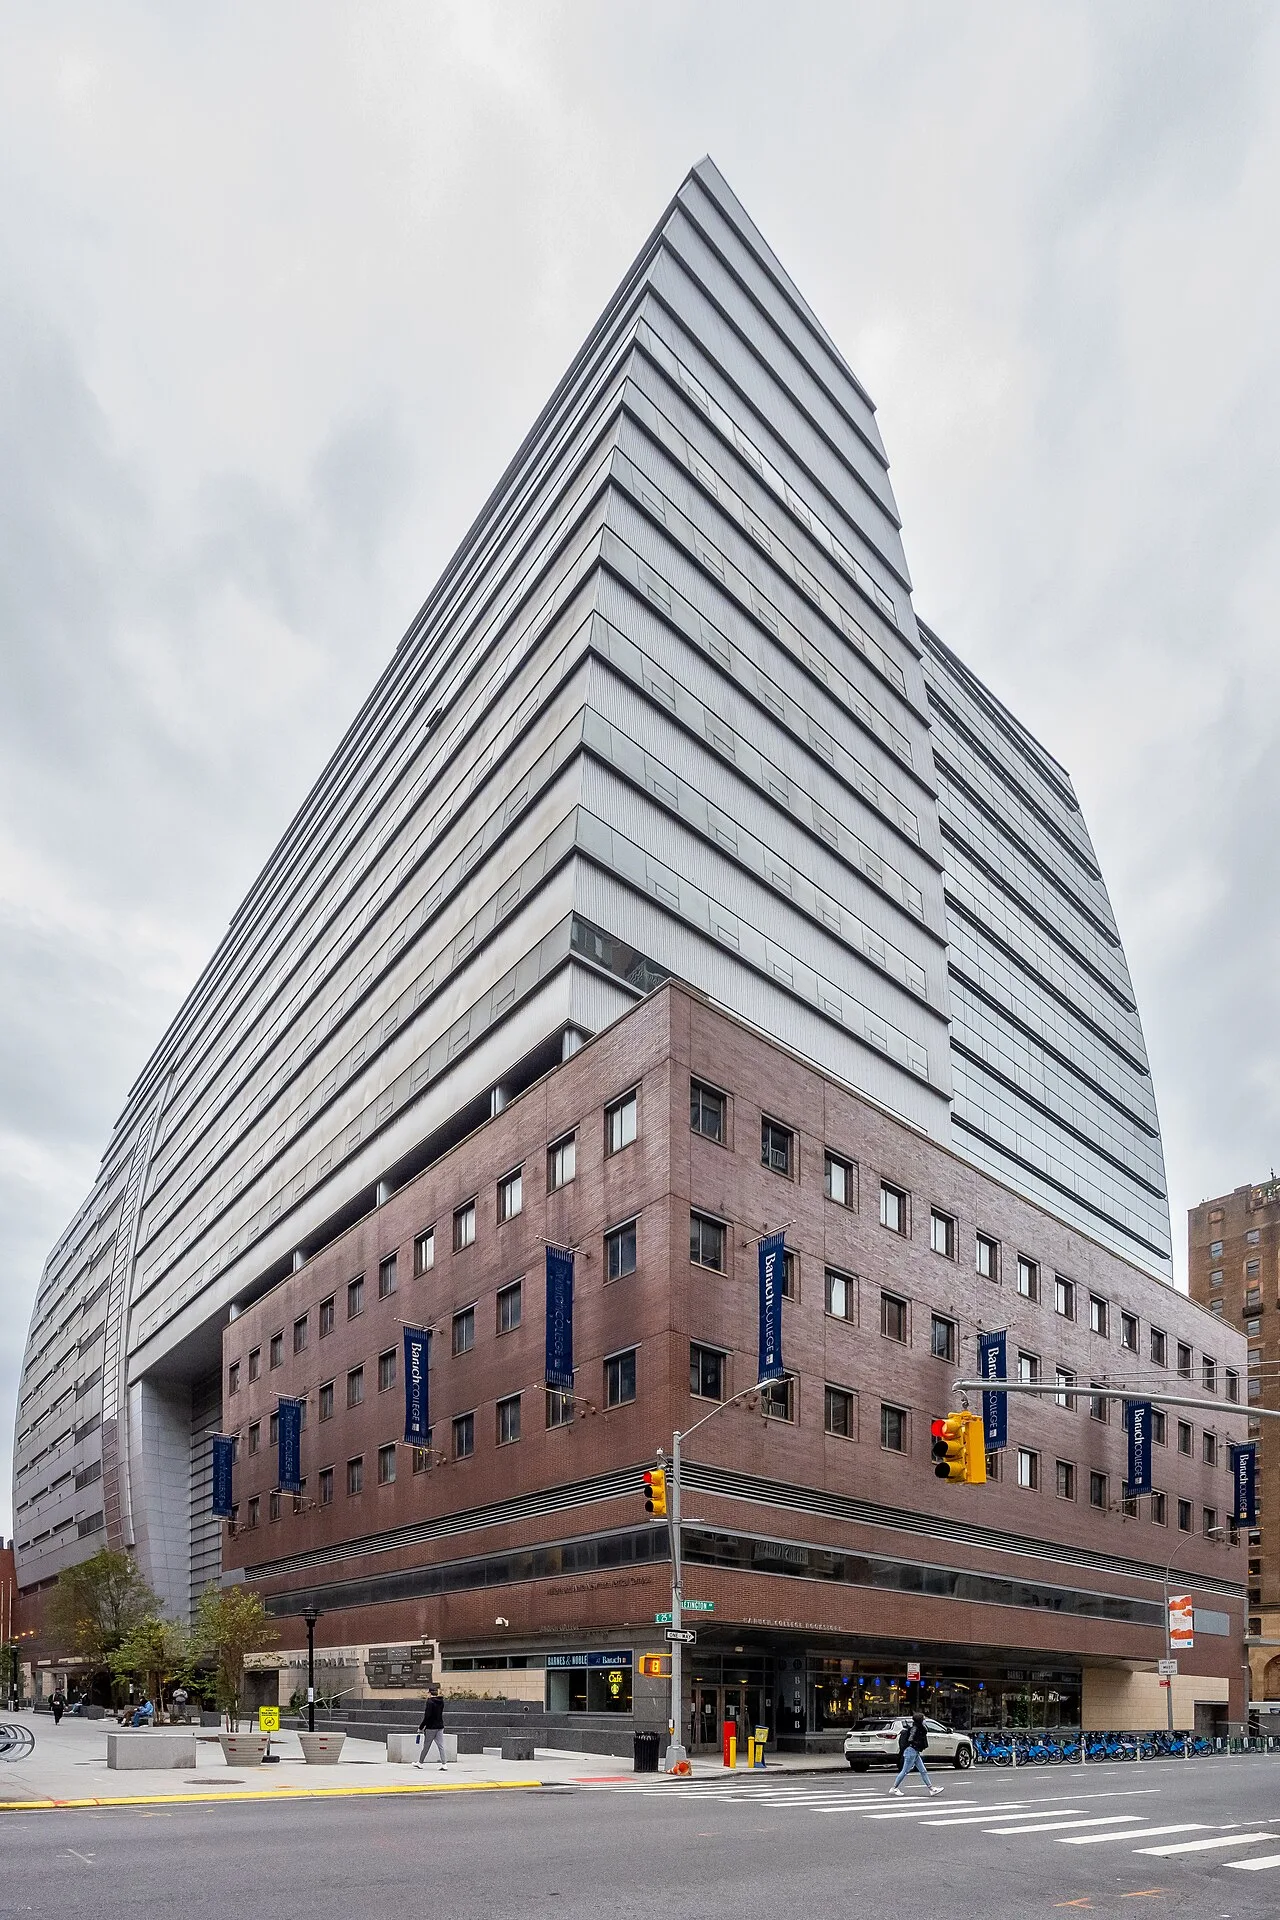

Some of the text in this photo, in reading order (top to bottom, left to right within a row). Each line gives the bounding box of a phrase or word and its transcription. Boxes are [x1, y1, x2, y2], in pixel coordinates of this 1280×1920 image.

[656, 1614, 660, 1622] E
[774, 1620, 803, 1629] COLLEGE
[547, 1655, 566, 1666] BARNES
[566, 1656, 572, 1666] &
[571, 1654, 588, 1666] NOBLE
[602, 1656, 622, 1664] Baruch
[608, 1674, 623, 1683] Café
